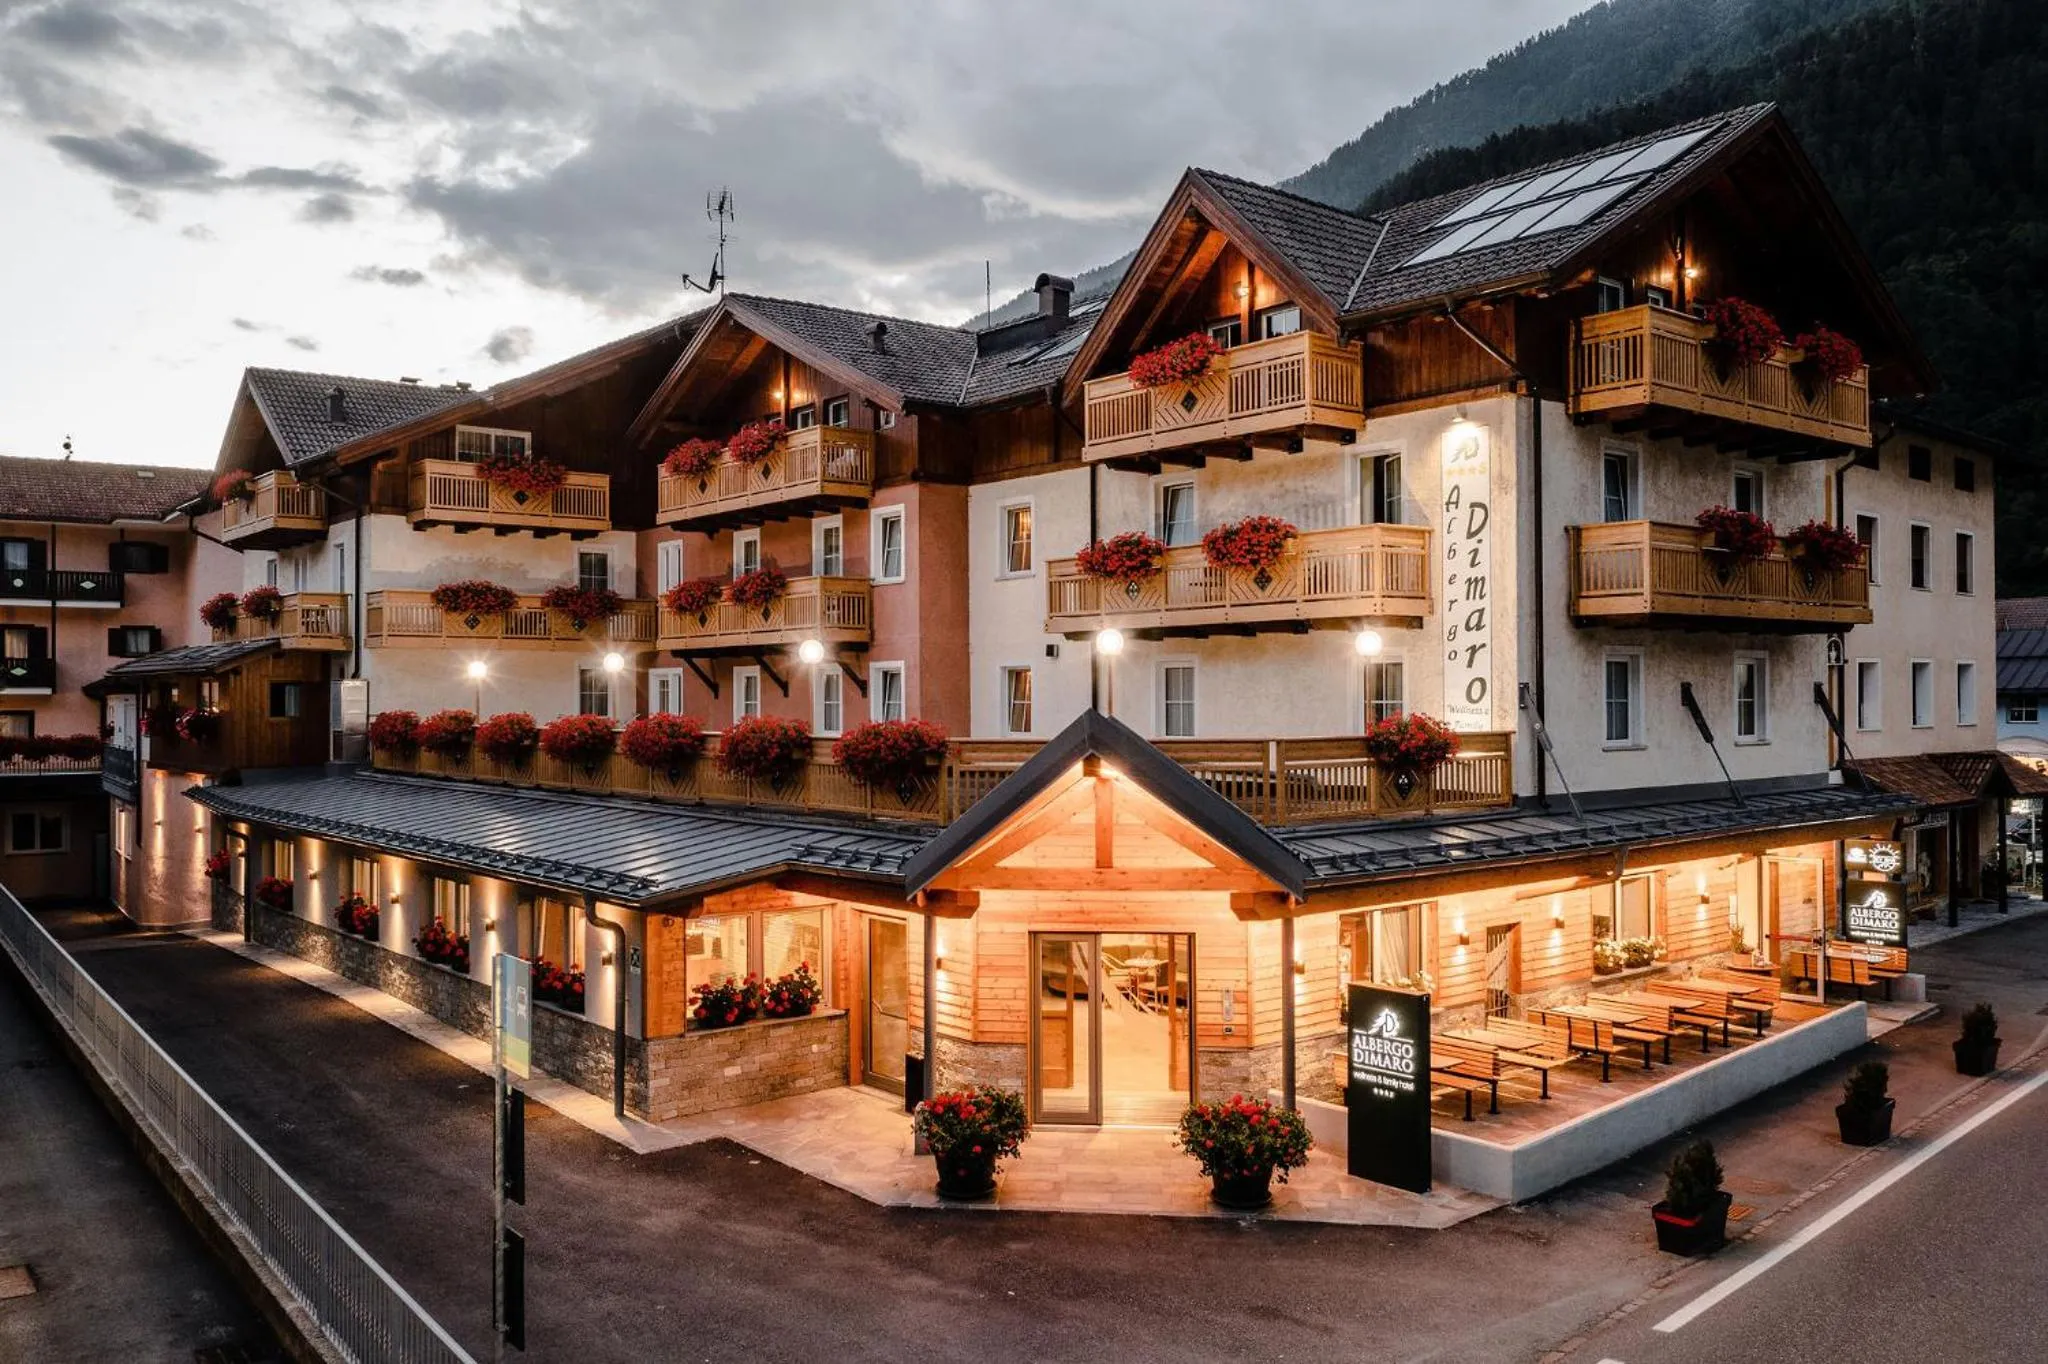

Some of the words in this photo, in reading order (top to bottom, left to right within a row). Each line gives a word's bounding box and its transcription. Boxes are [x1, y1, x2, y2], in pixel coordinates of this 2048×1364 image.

[1445, 485, 1461, 662] Albergo
[1465, 502, 1489, 704] Dimaro
[1850, 907, 1899, 920] ALBERGO
[1850, 917, 1899, 929] DIMARO
[1353, 1034, 1413, 1059] ALBERGO
[1353, 1049, 1413, 1073] DIMARO
